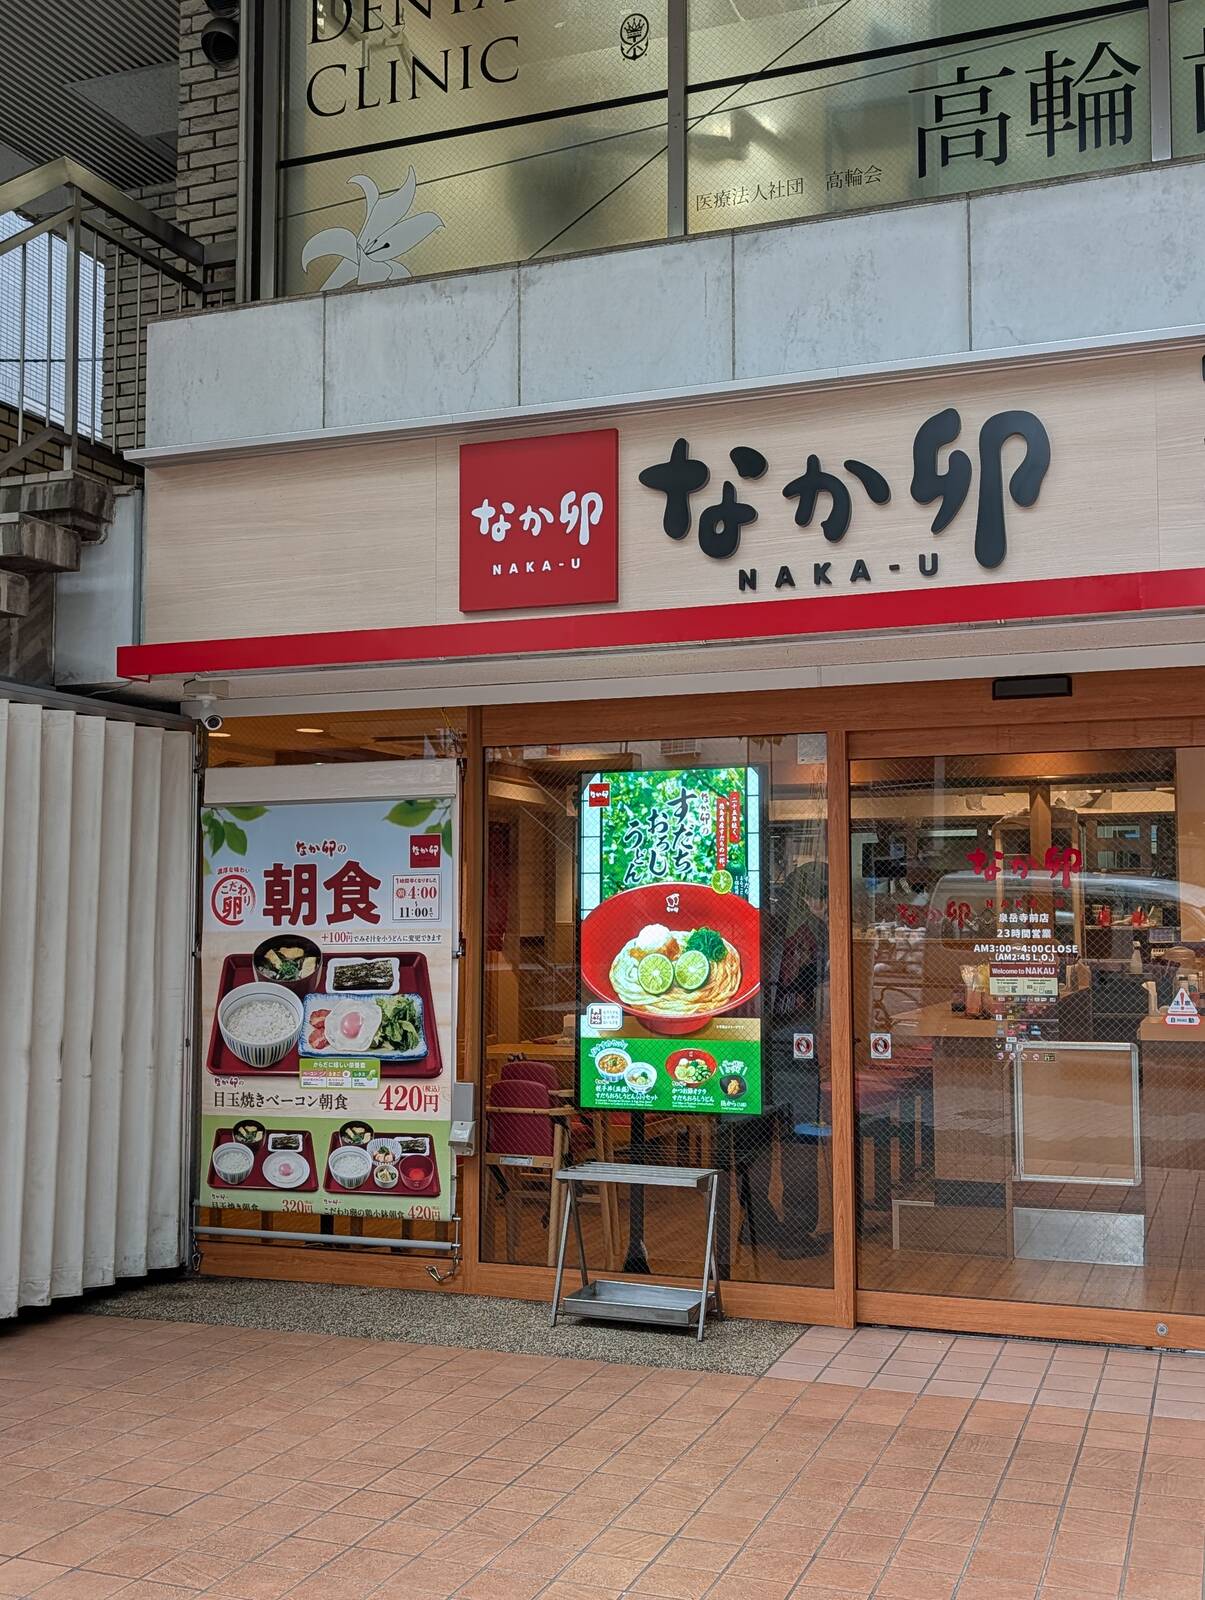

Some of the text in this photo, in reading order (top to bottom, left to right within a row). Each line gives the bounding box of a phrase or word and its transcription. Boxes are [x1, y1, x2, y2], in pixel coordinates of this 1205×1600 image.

[306, 35, 519, 117] CLINIC
[695, 163, 883, 213] 医療法人社団 高輪会
[638, 407, 1051, 569] なか卯
[471, 489, 604, 545] なか卯
[492, 557, 581, 576] NAKA-U
[738, 551, 940, 592] NAKA-U
[667, 787, 697, 872] すだち
[701, 793, 710, 835] なか卯の
[296, 840, 347, 857] なか卯の
[412, 843, 439, 856] なか卯
[624, 820, 643, 883] うどん
[648, 809, 670, 876] おろし
[966, 848, 1082, 889] なか卯
[263, 860, 382, 926] 朝食
[996, 929, 1052, 938] 23時間営業
[998, 913, 1049, 923] 泉岳寺前店
[214, 1090, 348, 1110] 目玉焼きベーコン朝食
[379, 1085, 438, 1112] 420円
[408, 1205, 441, 1220] 420円
